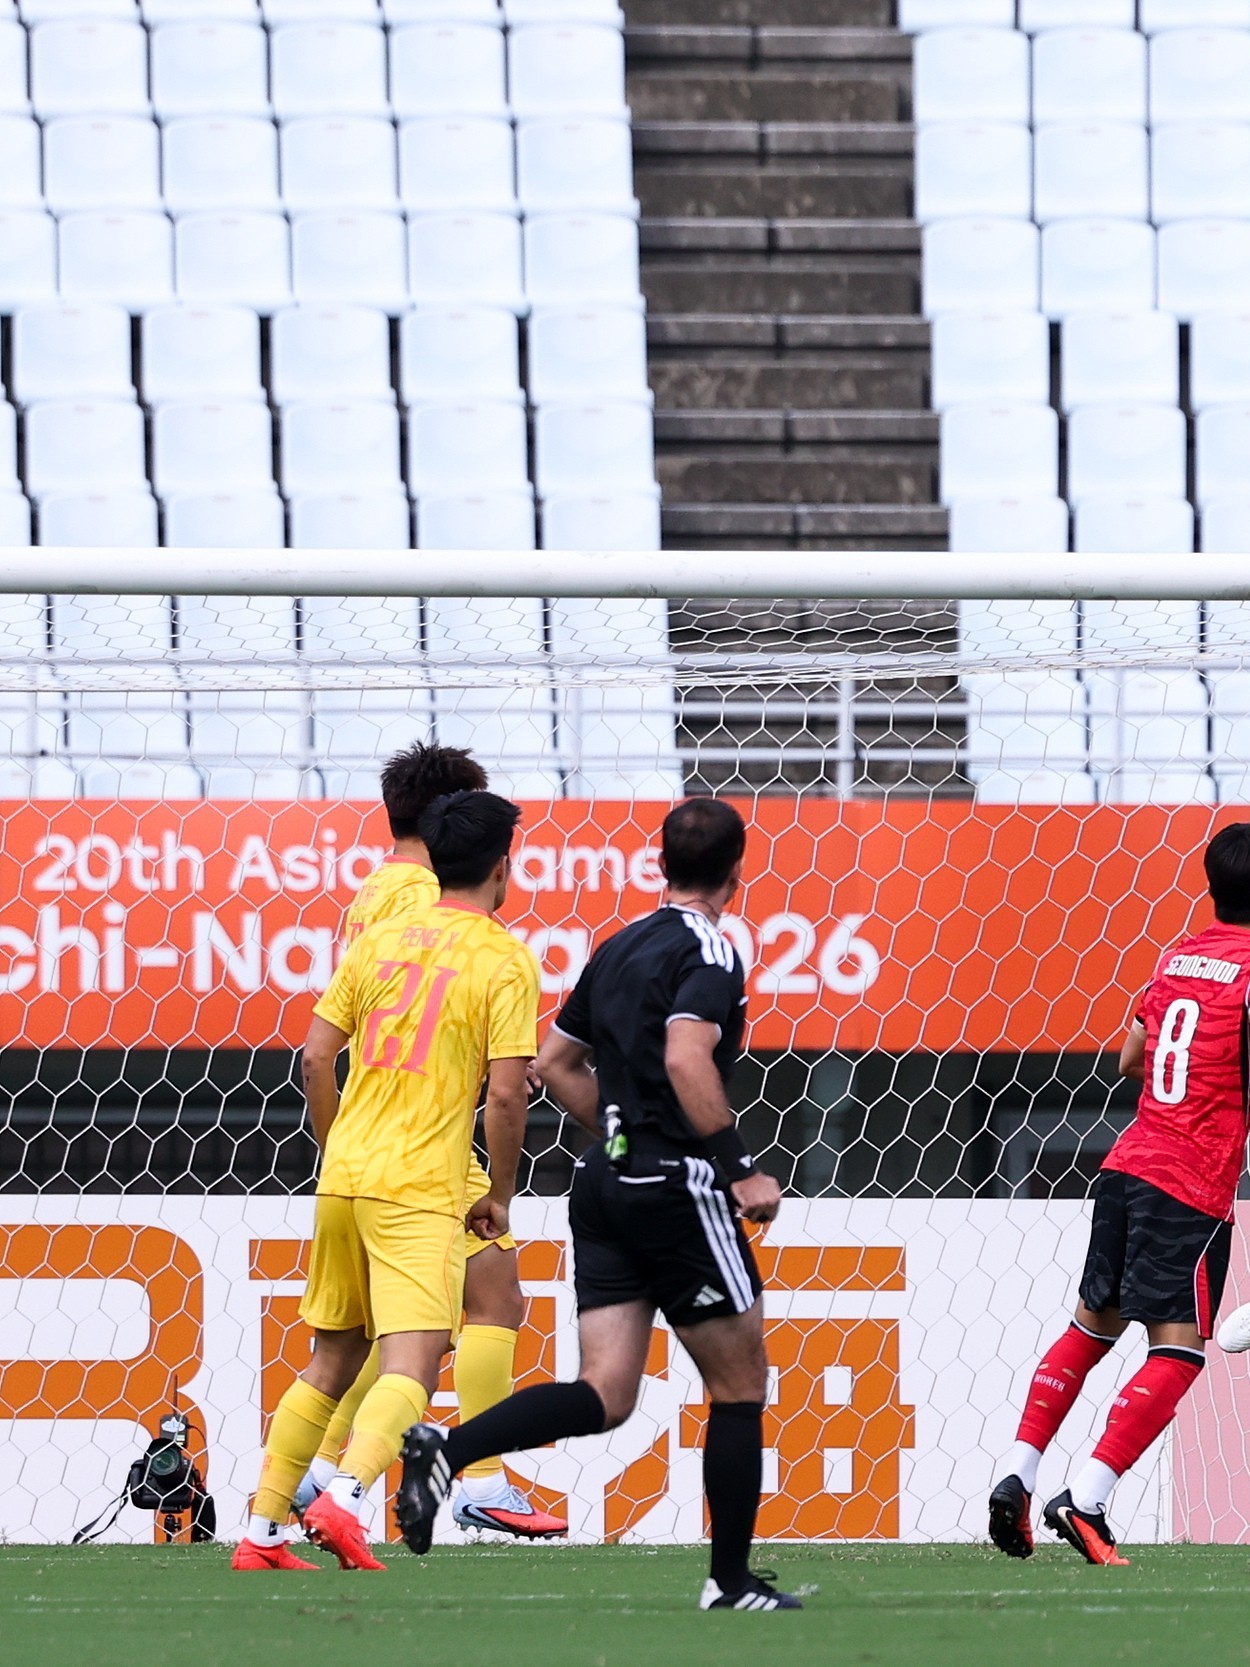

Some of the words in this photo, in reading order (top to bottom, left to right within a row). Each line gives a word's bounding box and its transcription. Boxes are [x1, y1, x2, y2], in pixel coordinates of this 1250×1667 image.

[33, 829, 206, 893] 20th
[228, 828, 385, 893] Asia
[510, 845, 668, 894] ame
[399, 926, 442, 948] PENG
[443, 931, 460, 951] X
[363, 960, 460, 1077] 21
[1152, 998, 1201, 1105] 8
